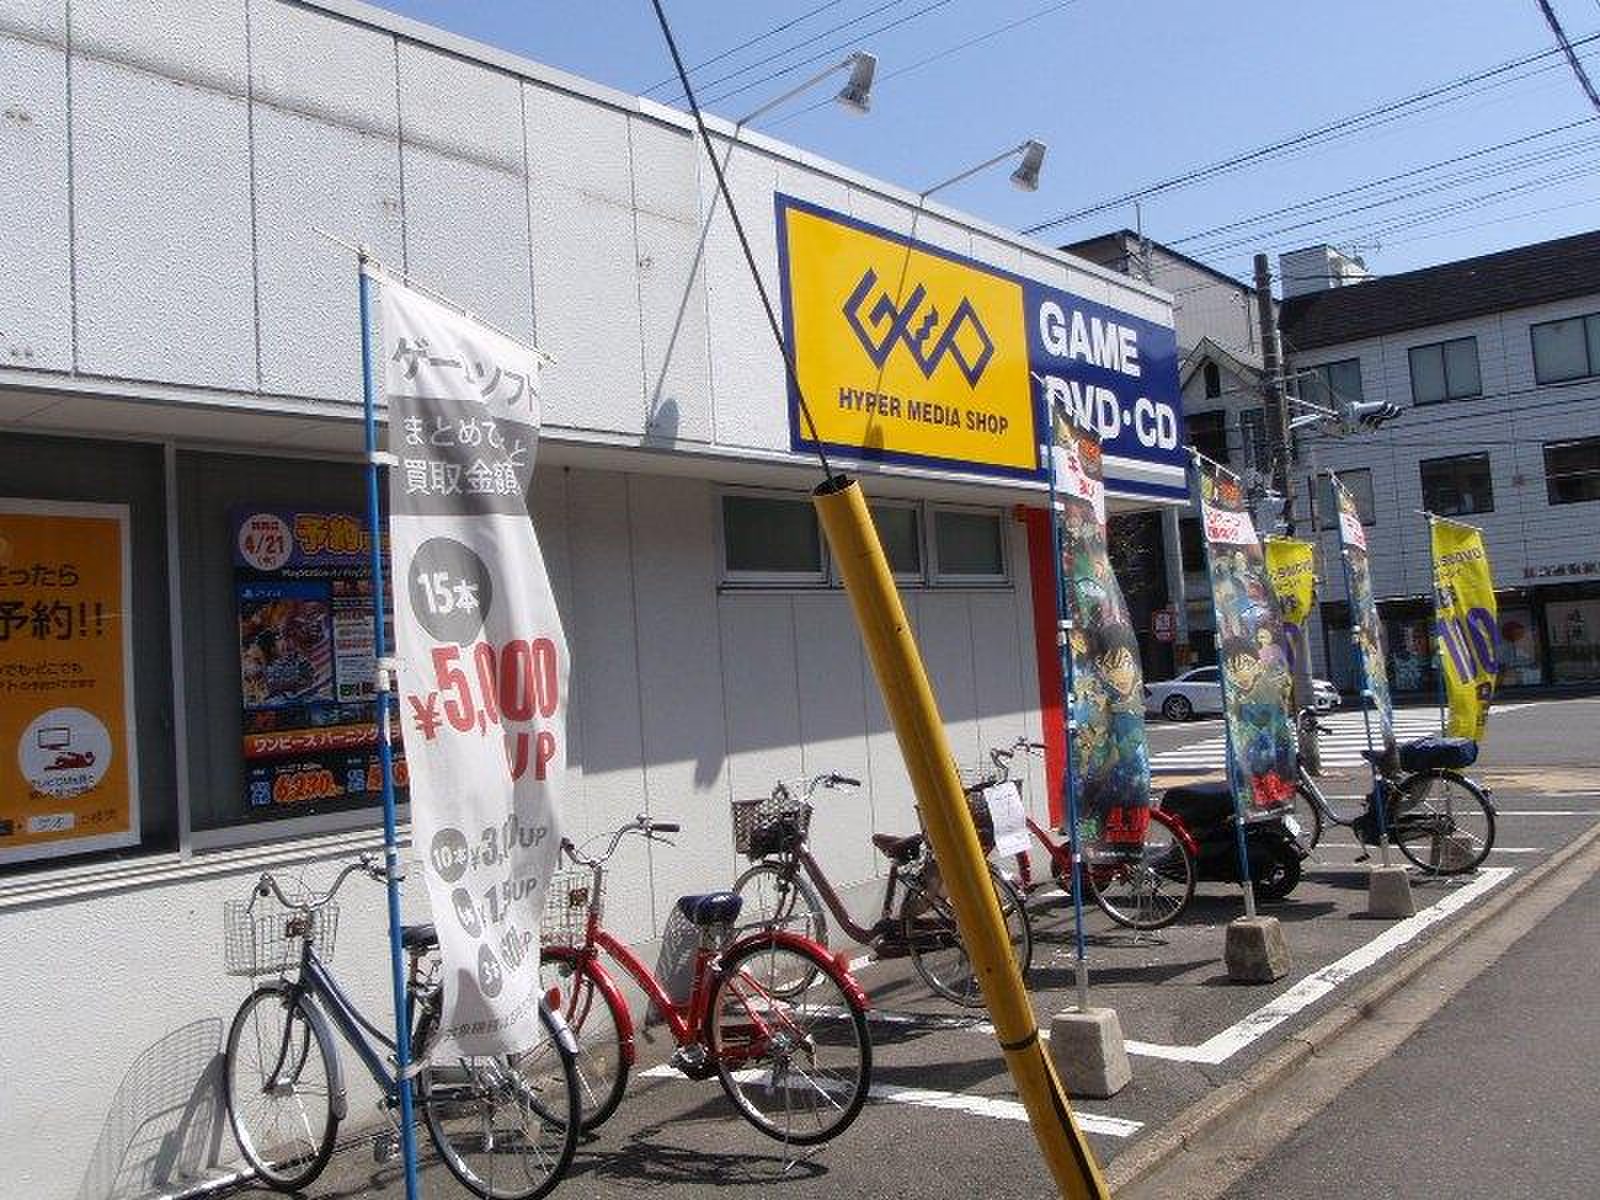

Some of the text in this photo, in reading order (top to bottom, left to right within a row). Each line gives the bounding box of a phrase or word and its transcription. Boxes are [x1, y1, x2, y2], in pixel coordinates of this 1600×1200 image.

[1039, 301, 1141, 377] GAME
[839, 386, 1009, 435] HYPER MEDIA SHOP
[417, 572, 481, 615] 15本
